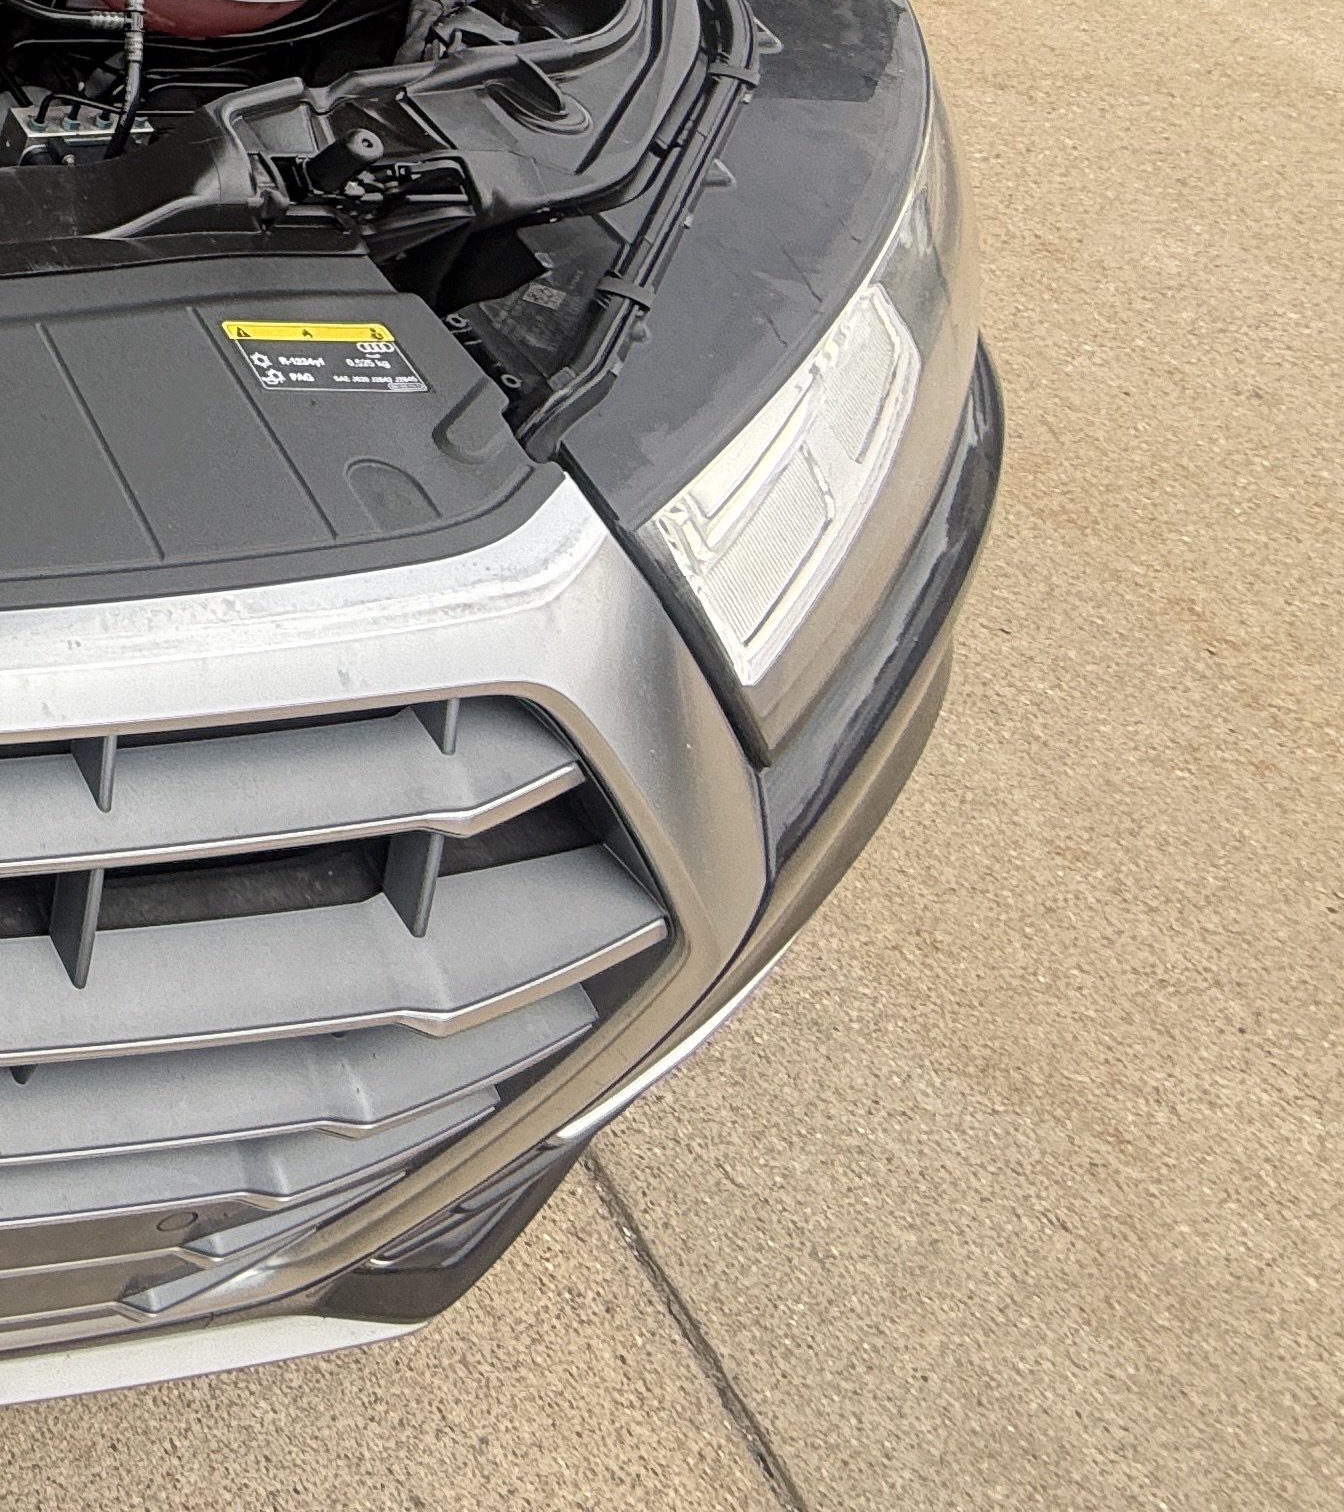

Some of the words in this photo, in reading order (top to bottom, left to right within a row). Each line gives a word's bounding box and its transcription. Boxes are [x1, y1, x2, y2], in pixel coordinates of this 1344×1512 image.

[278, 356, 326, 368] R-1234yf
[374, 359, 392, 369] kg
[288, 372, 316, 382] PAG
